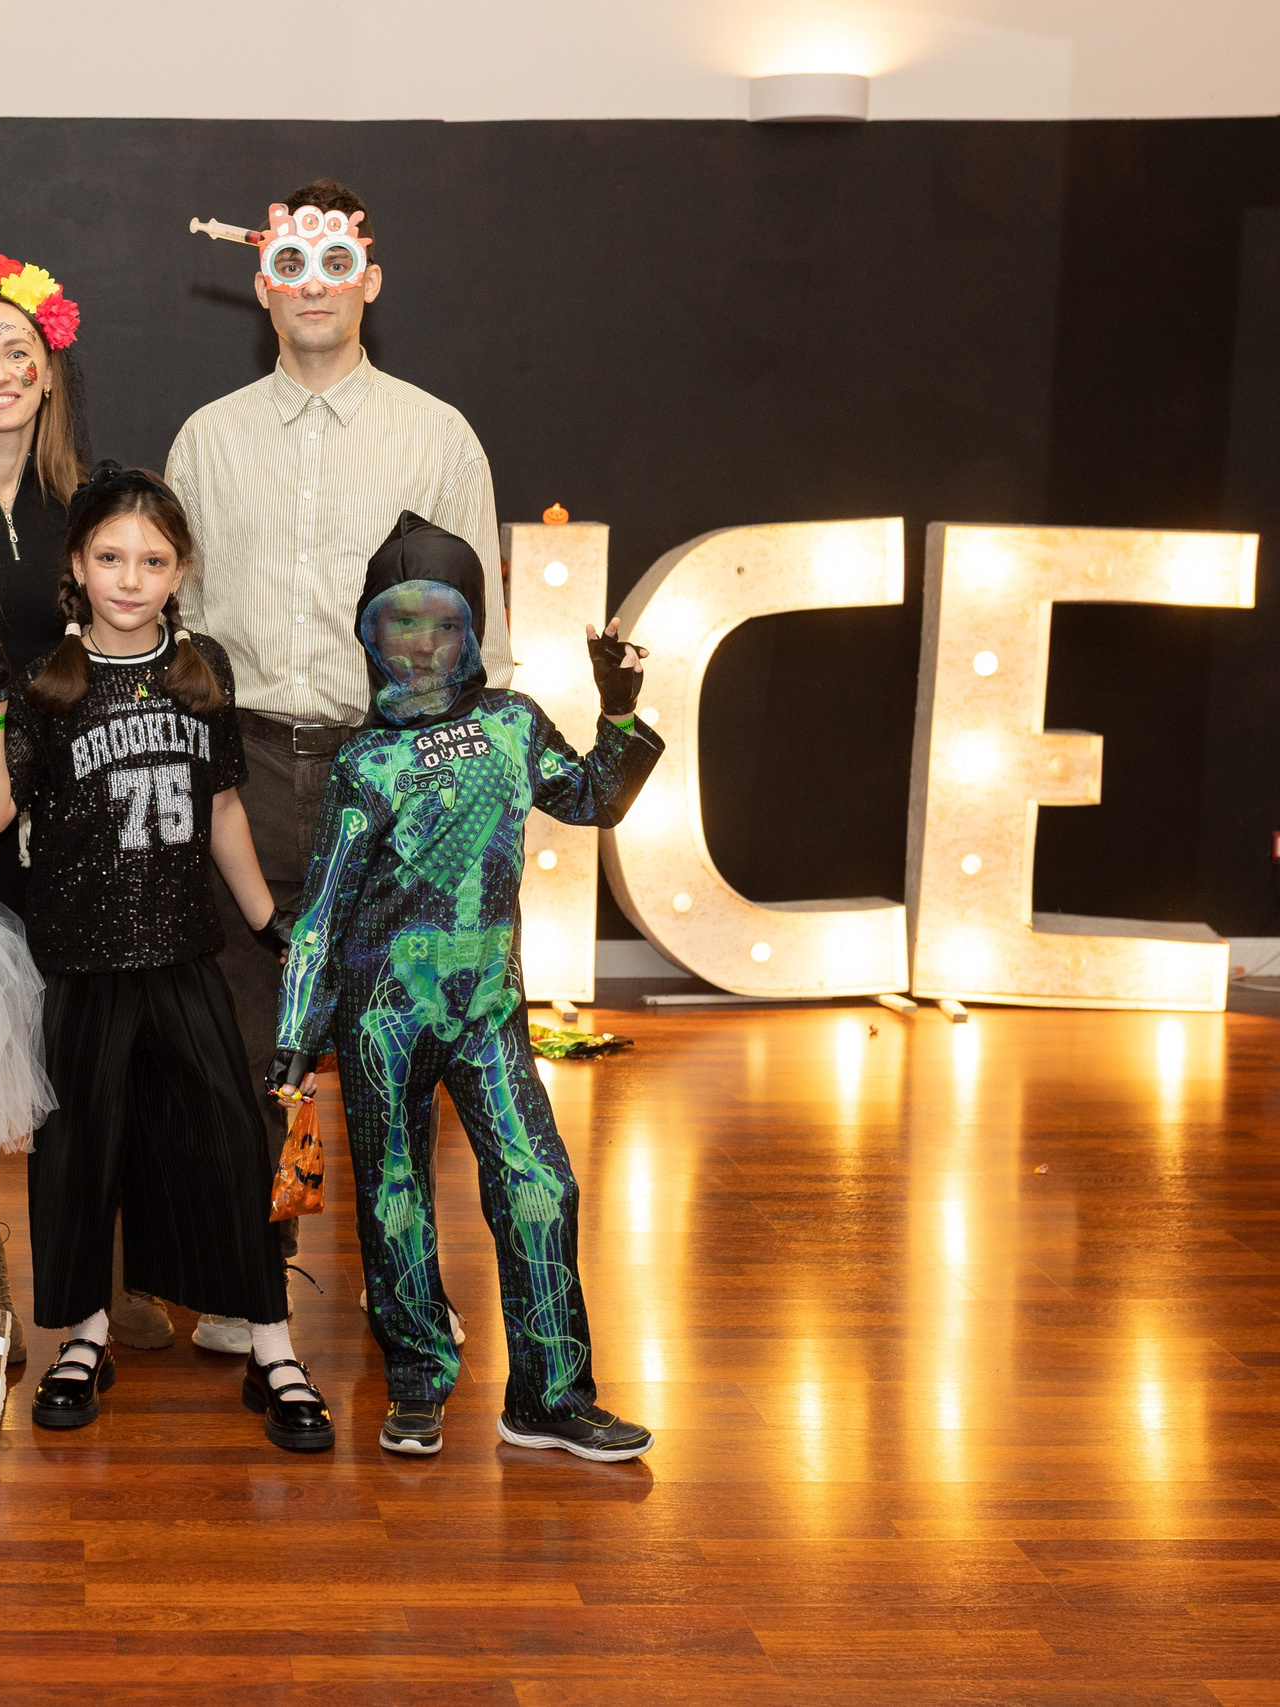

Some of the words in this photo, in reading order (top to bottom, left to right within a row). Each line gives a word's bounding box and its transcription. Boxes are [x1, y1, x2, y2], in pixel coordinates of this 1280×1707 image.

[71, 712, 210, 780] BROOKLYN
[416, 724, 483, 751] GAME
[424, 741, 490, 768] OVER
[107, 762, 194, 850] 75
